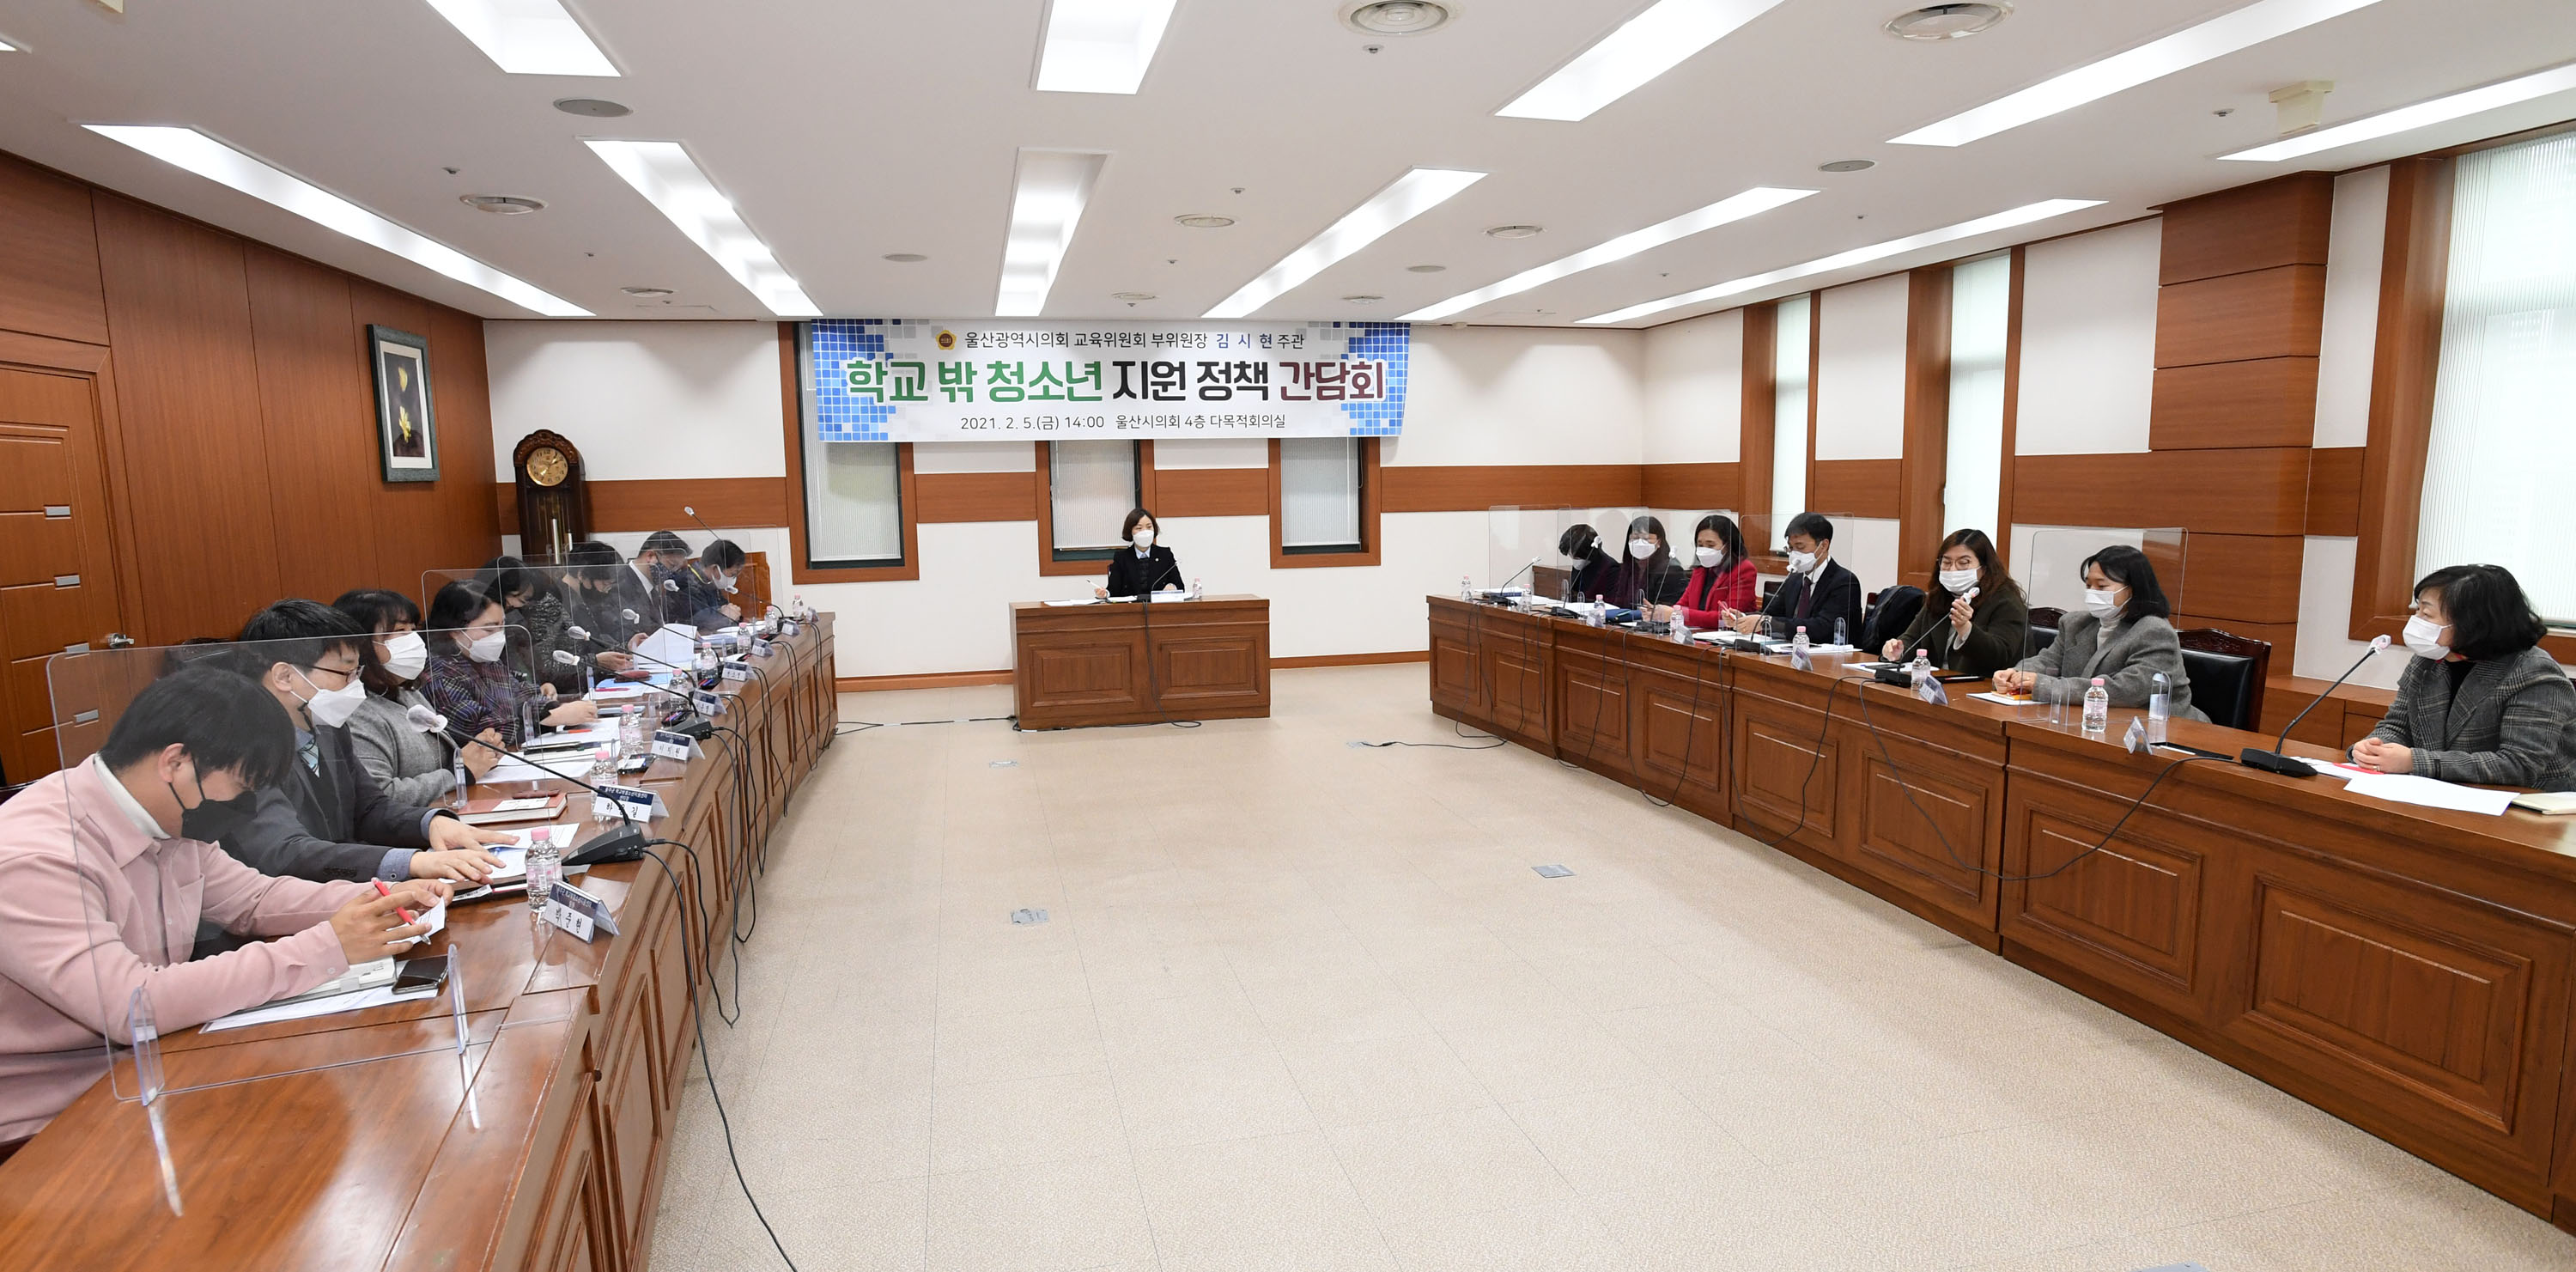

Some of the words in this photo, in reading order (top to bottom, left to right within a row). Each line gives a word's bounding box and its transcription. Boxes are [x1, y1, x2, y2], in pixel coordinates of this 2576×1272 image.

[964, 332, 1069, 349] 울산광역시의회
[1073, 332, 1146, 348] 교육위원회
[1151, 332, 1208, 349] 부위원장
[1216, 333, 1229, 349] 김
[1238, 333, 1251, 349] 시
[1259, 333, 1273, 350] 현
[1277, 333, 1305, 350] 주관
[847, 361, 929, 403] 학교
[938, 361, 978, 403] 밖
[987, 361, 1103, 403] 청소년
[1112, 361, 1187, 401] 지원
[1196, 361, 1269, 401] 정책
[1279, 361, 1383, 401] 간담회
[961, 417, 1001, 429] 2021.
[1005, 417, 1018, 429] 2.
[1065, 416, 1105, 428] 14:00
[1115, 414, 1181, 429] 울산시의회
[1184, 415, 1206, 429] 4층
[1210, 414, 1285, 429] 다목적회의실
